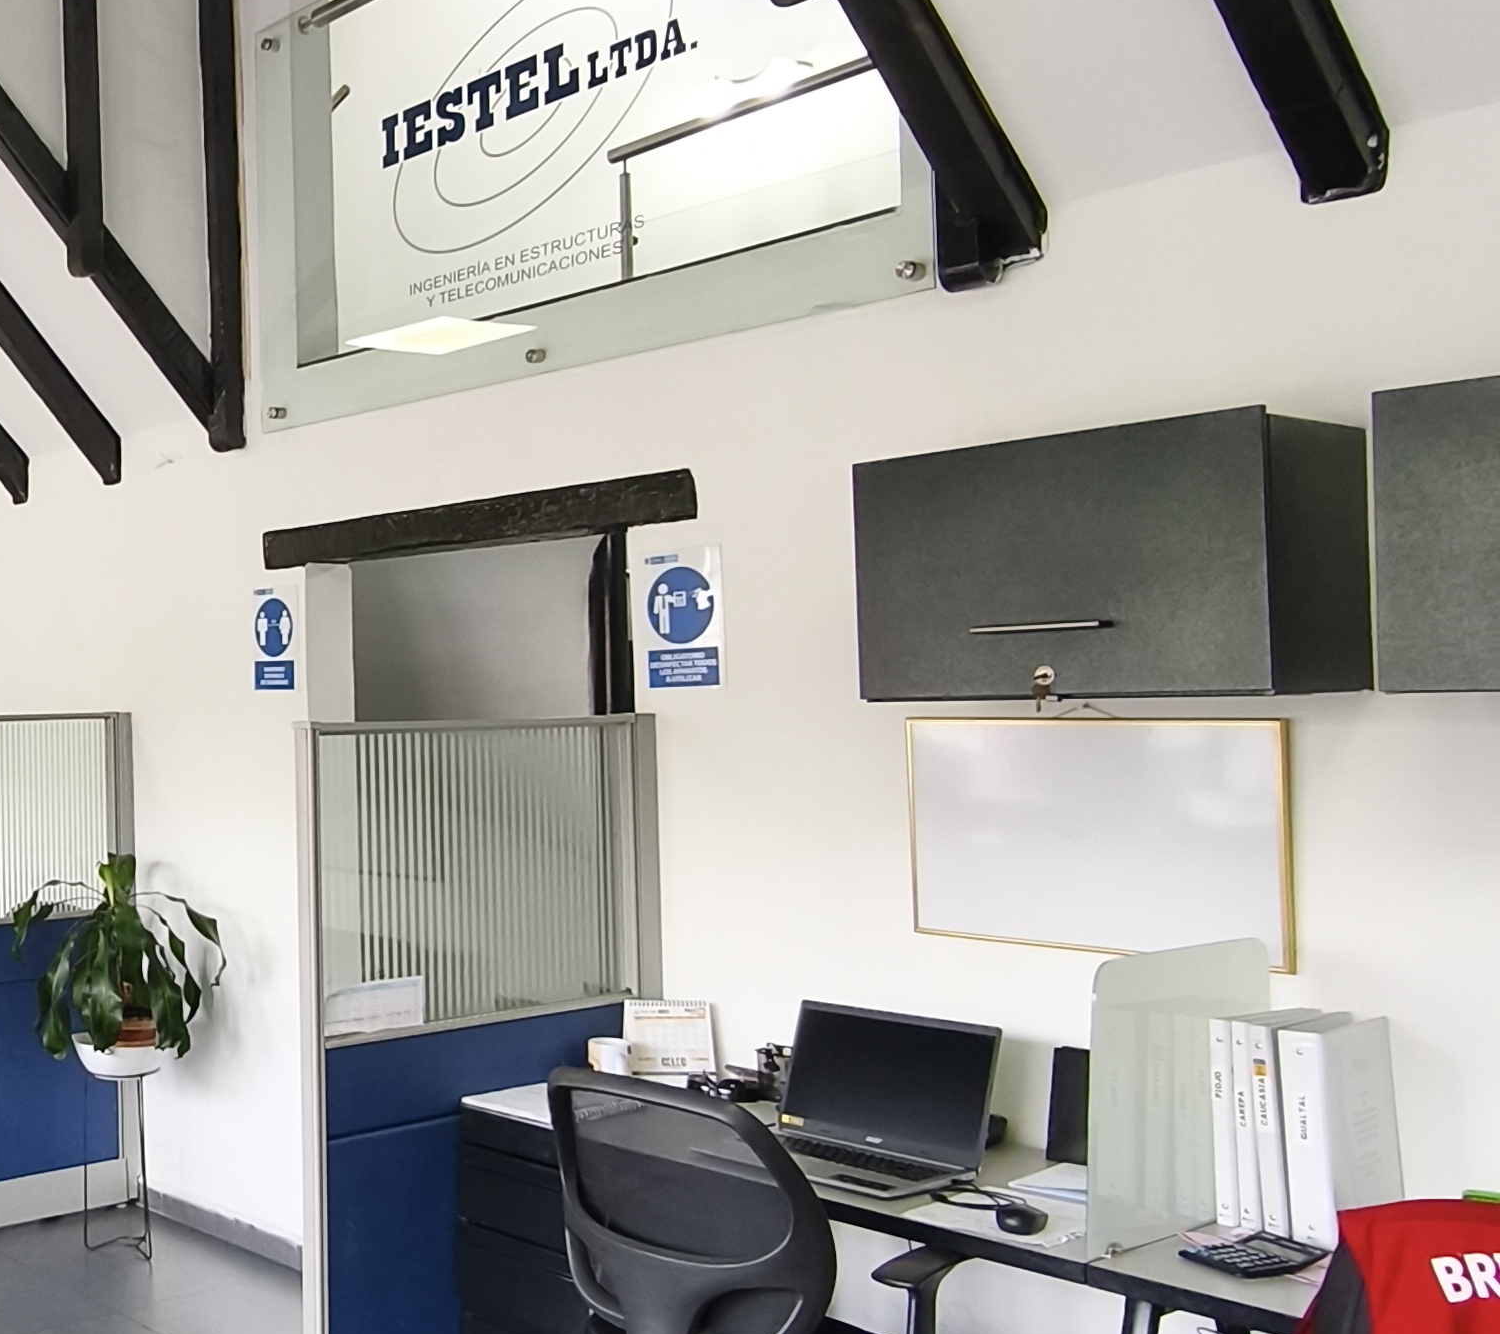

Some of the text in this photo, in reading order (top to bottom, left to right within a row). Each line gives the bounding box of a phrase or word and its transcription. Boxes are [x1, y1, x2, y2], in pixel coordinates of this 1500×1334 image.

[382, 17, 699, 169] IESTEL LTDA.
[409, 214, 645, 296] INGENIERÍA EN ESTRUCTURAS
[426, 240, 625, 308] Y TELECOMUNICACIONES
[1237, 1090, 1247, 1128] CAREPA
[1257, 1077, 1268, 1127] CAUCASIA
[1298, 1095, 1308, 1141] GUALTAL
[1430, 1252, 1500, 1303] BR
